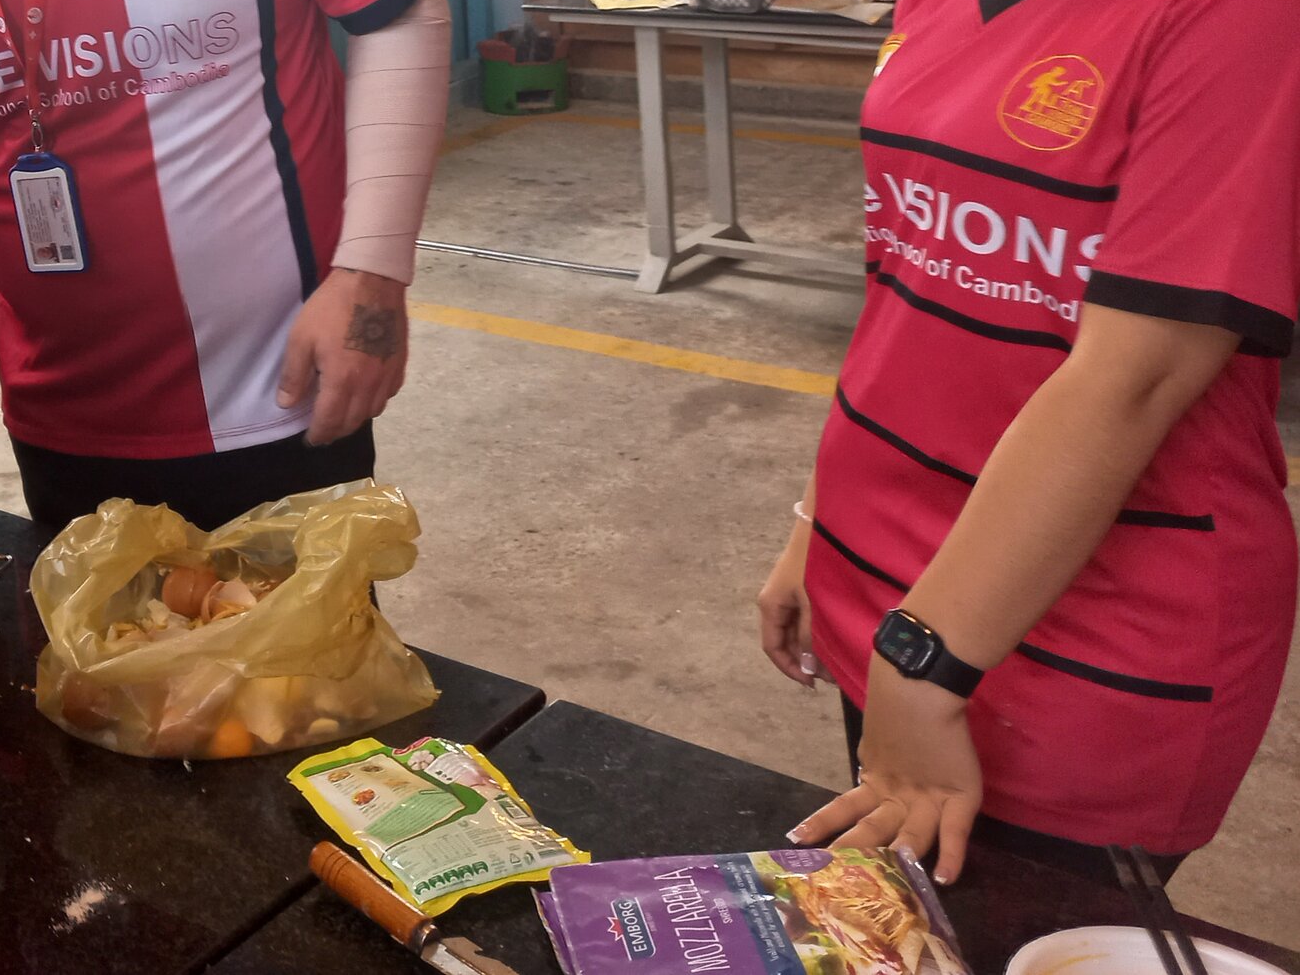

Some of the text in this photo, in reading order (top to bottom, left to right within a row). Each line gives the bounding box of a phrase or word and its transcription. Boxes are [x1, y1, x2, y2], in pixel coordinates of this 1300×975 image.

[38, 10, 240, 82] VISIONS
[98, 80, 118, 101] of
[618, 900, 648, 953] EMBORG
[653, 866, 731, 973] MOZZARELLA
